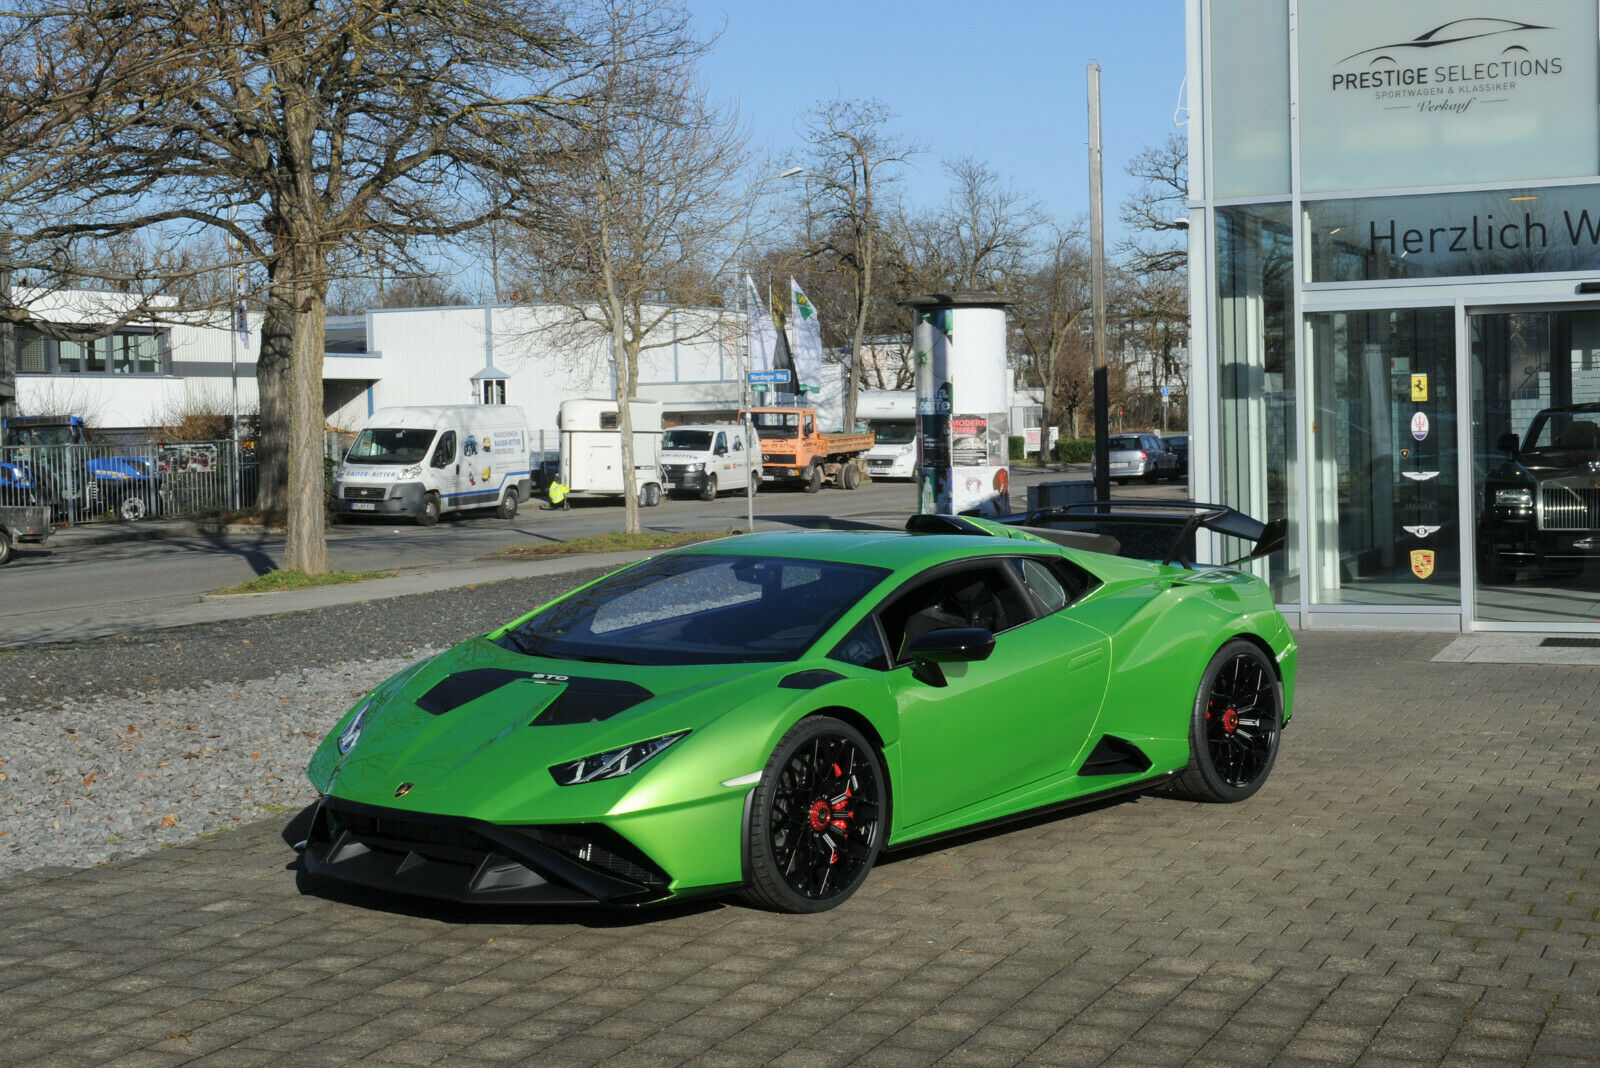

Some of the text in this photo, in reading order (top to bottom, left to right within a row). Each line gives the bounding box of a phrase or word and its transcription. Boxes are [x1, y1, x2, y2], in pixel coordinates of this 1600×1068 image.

[1332, 57, 1563, 91] PRESTIGE SELECTIONS
[1375, 81, 1516, 99] SPORTWAGEN & KLASSIKER
[1416, 97, 1476, 114] Verkauf
[1370, 212, 1547, 255] Herzlich
[951, 419, 986, 427] MODERN
